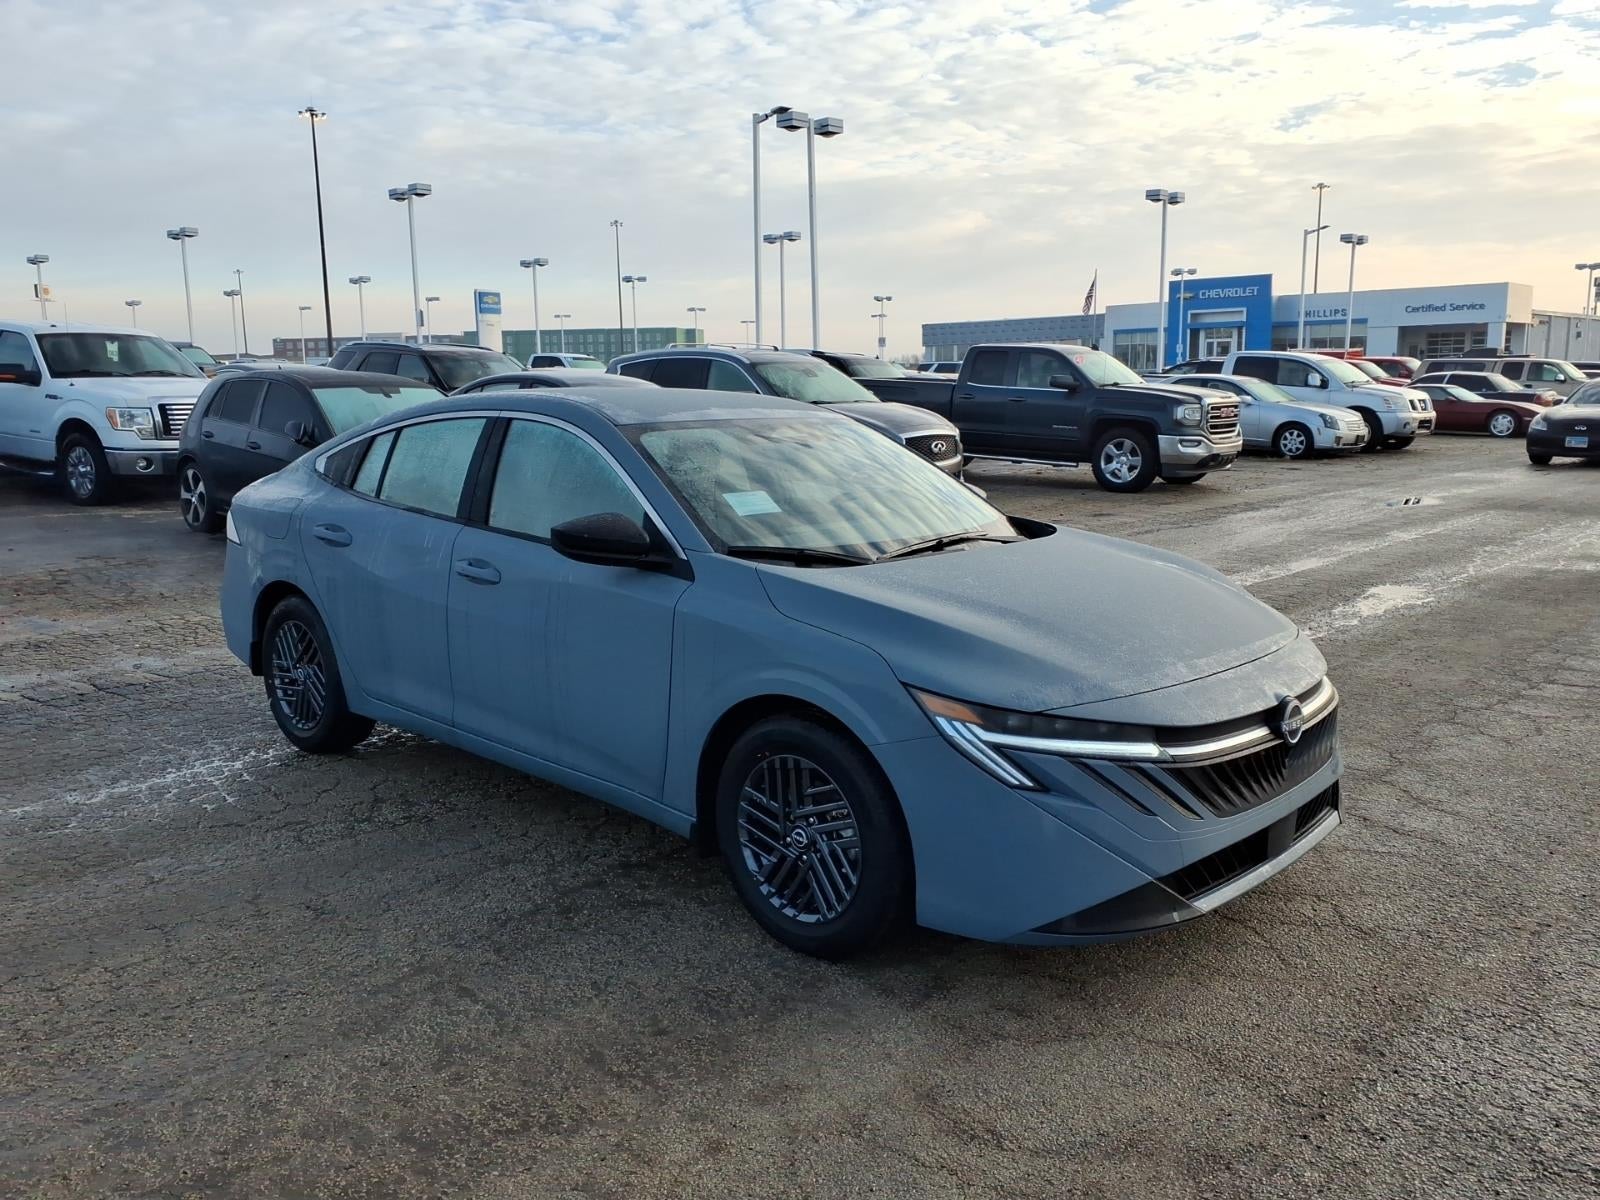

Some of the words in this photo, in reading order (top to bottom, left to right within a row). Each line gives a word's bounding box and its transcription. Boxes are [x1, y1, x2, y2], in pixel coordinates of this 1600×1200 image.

[1199, 286, 1259, 299] CHEVROLET
[1405, 303, 1446, 313] Certified
[1449, 301, 1486, 311] Service
